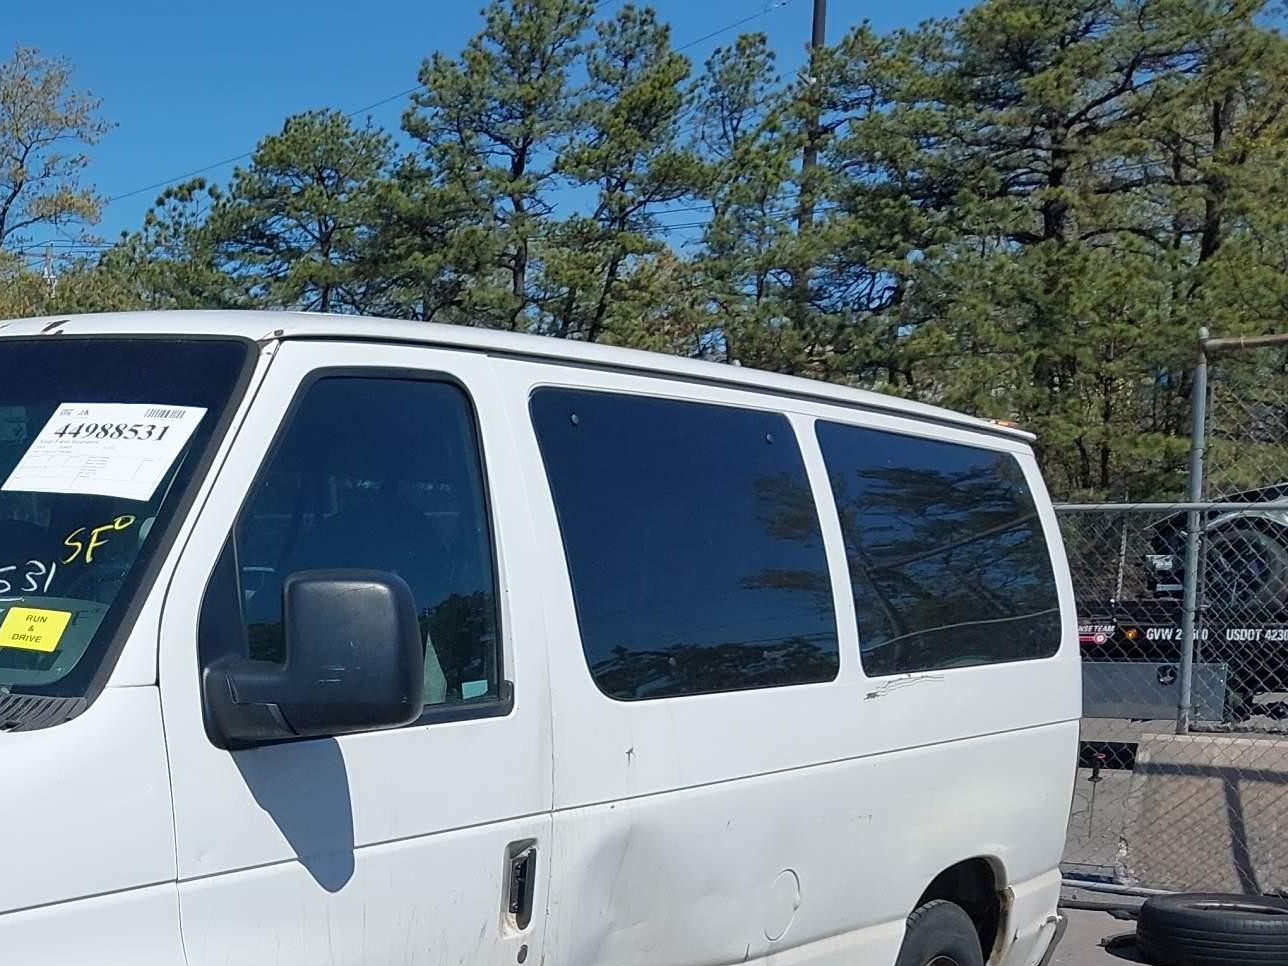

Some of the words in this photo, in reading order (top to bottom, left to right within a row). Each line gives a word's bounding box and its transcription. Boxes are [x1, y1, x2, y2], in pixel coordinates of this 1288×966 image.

[54, 422, 170, 441] 44988531
[25, 614, 48, 623] RUN
[11, 633, 43, 643] DRIVE
[1146, 627, 1172, 641] GVW
[1226, 628, 1263, 641] USDOT
